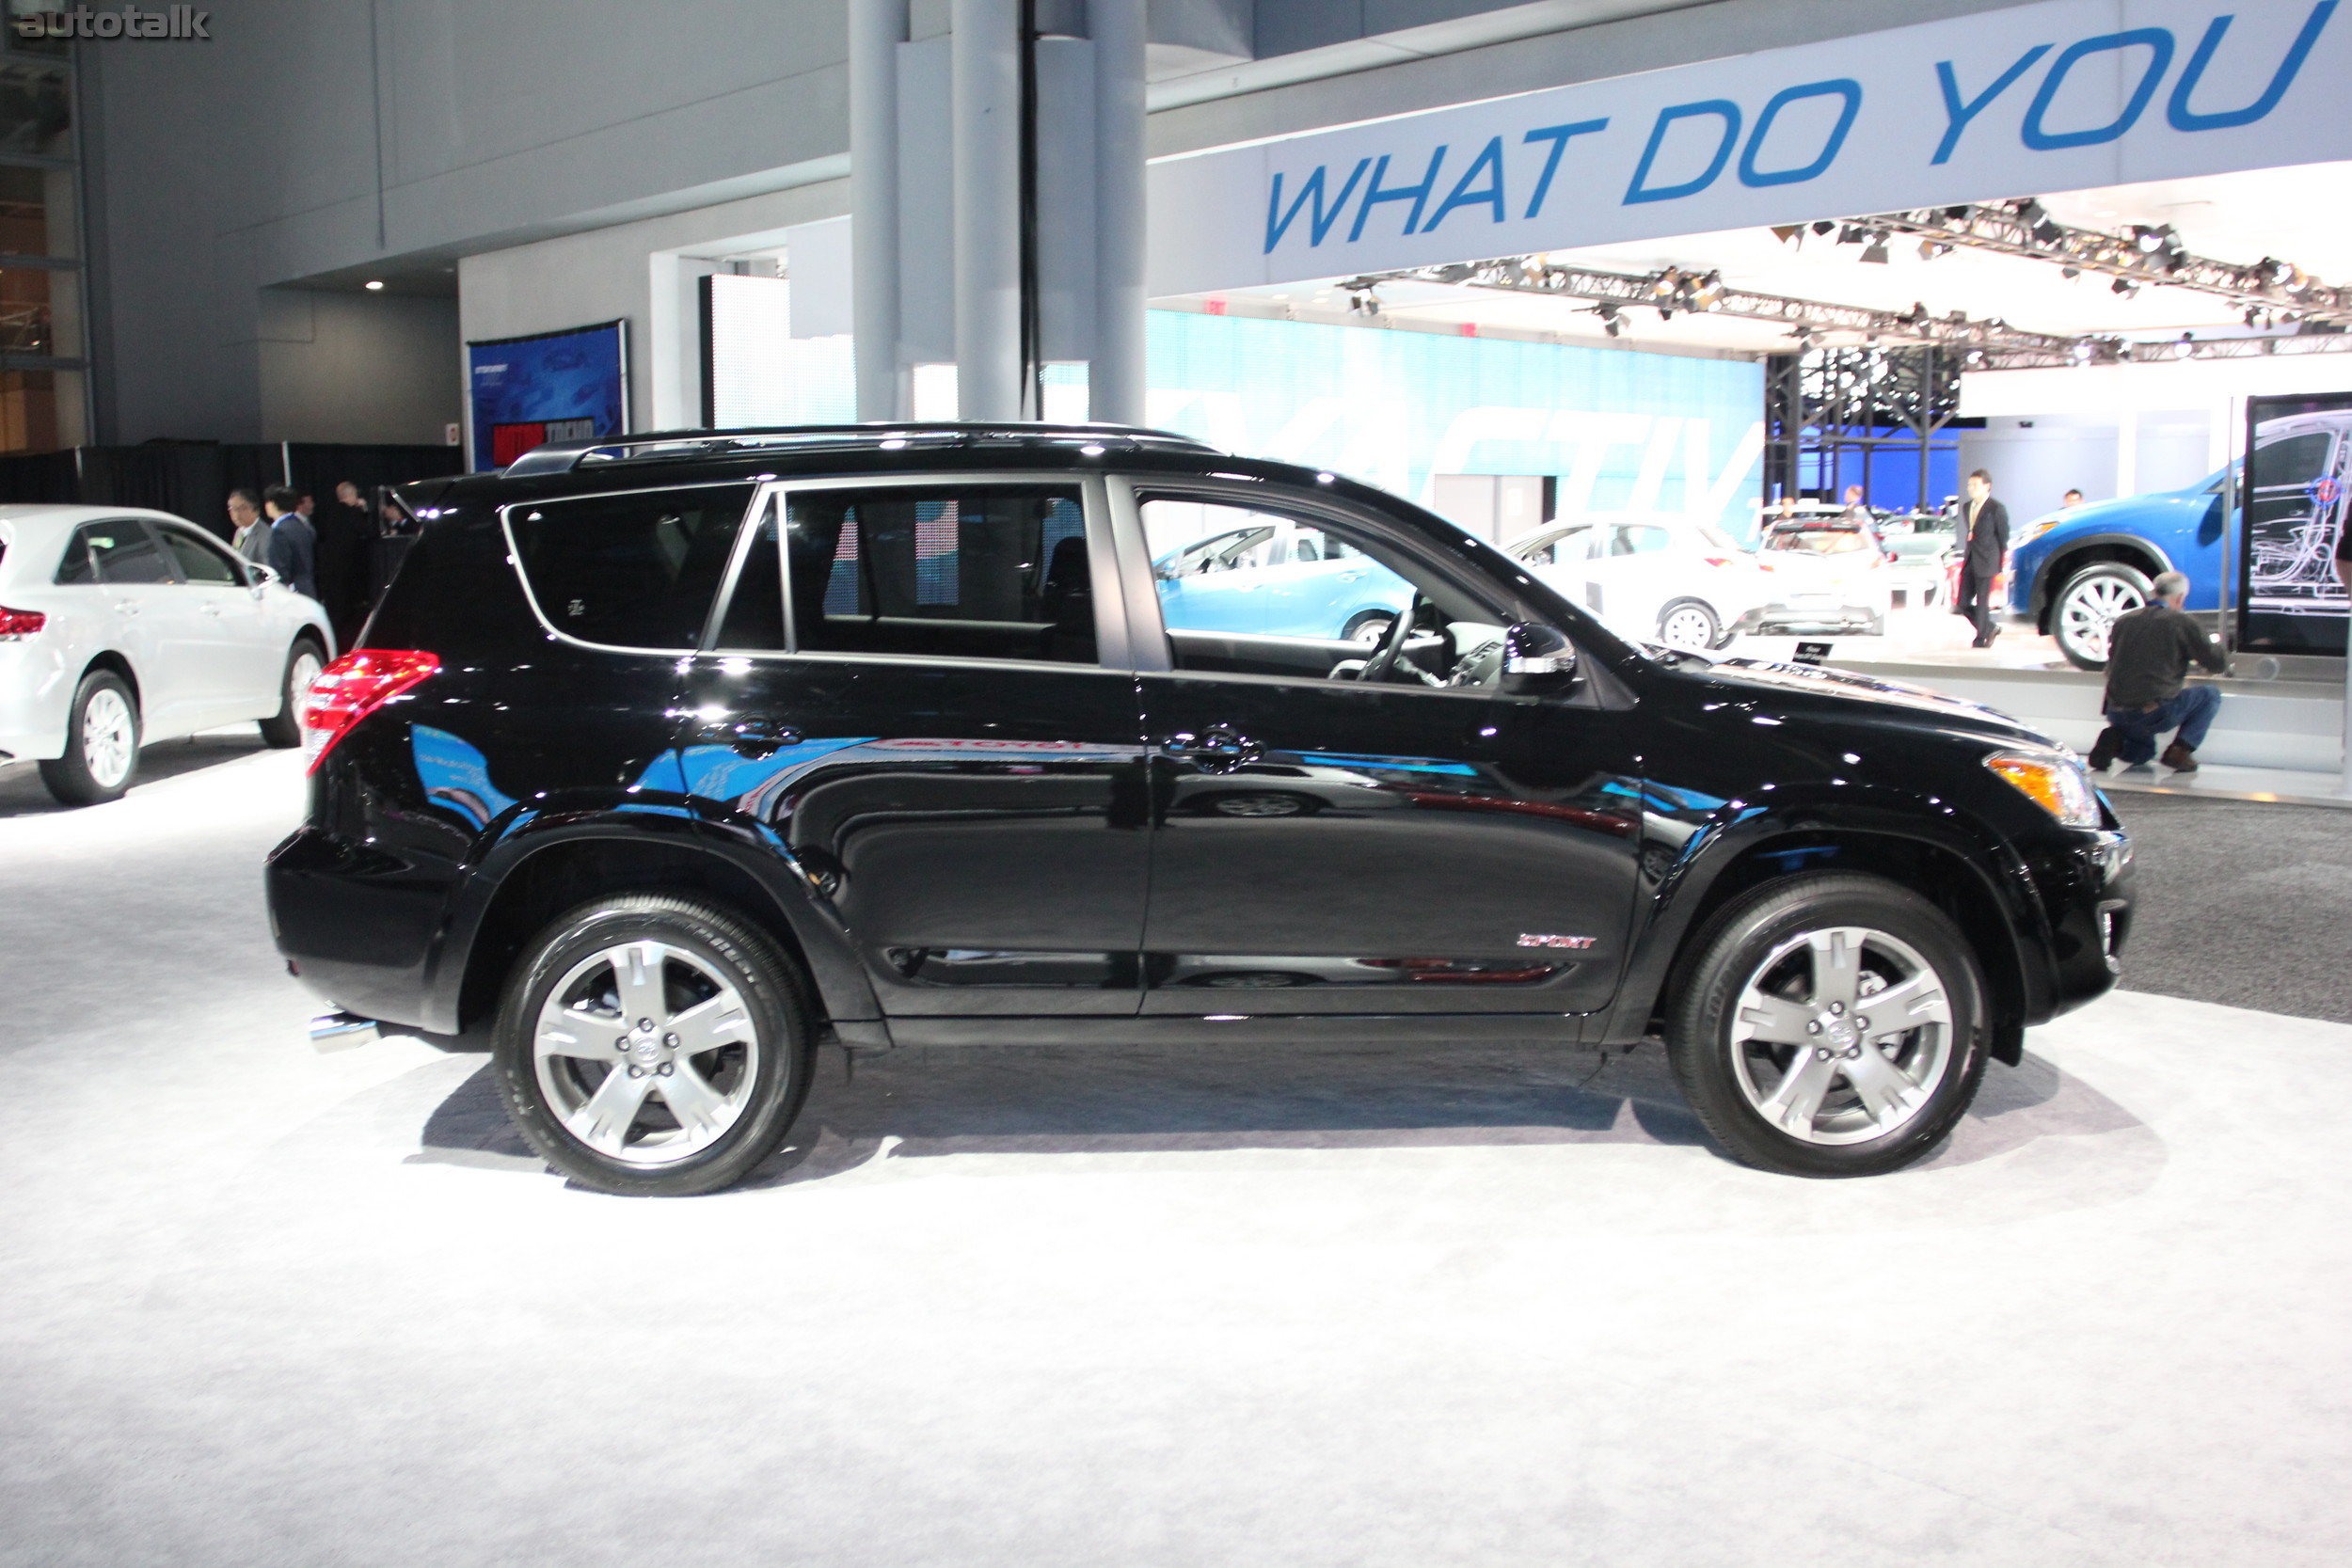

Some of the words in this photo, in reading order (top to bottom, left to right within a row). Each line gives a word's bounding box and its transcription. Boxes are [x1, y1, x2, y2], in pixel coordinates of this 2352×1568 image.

[1264, 117, 1611, 254] WHAT
[1621, 77, 1864, 205] DO
[1931, 0, 2341, 165] YOU
[1517, 933, 1597, 949] SPORT
